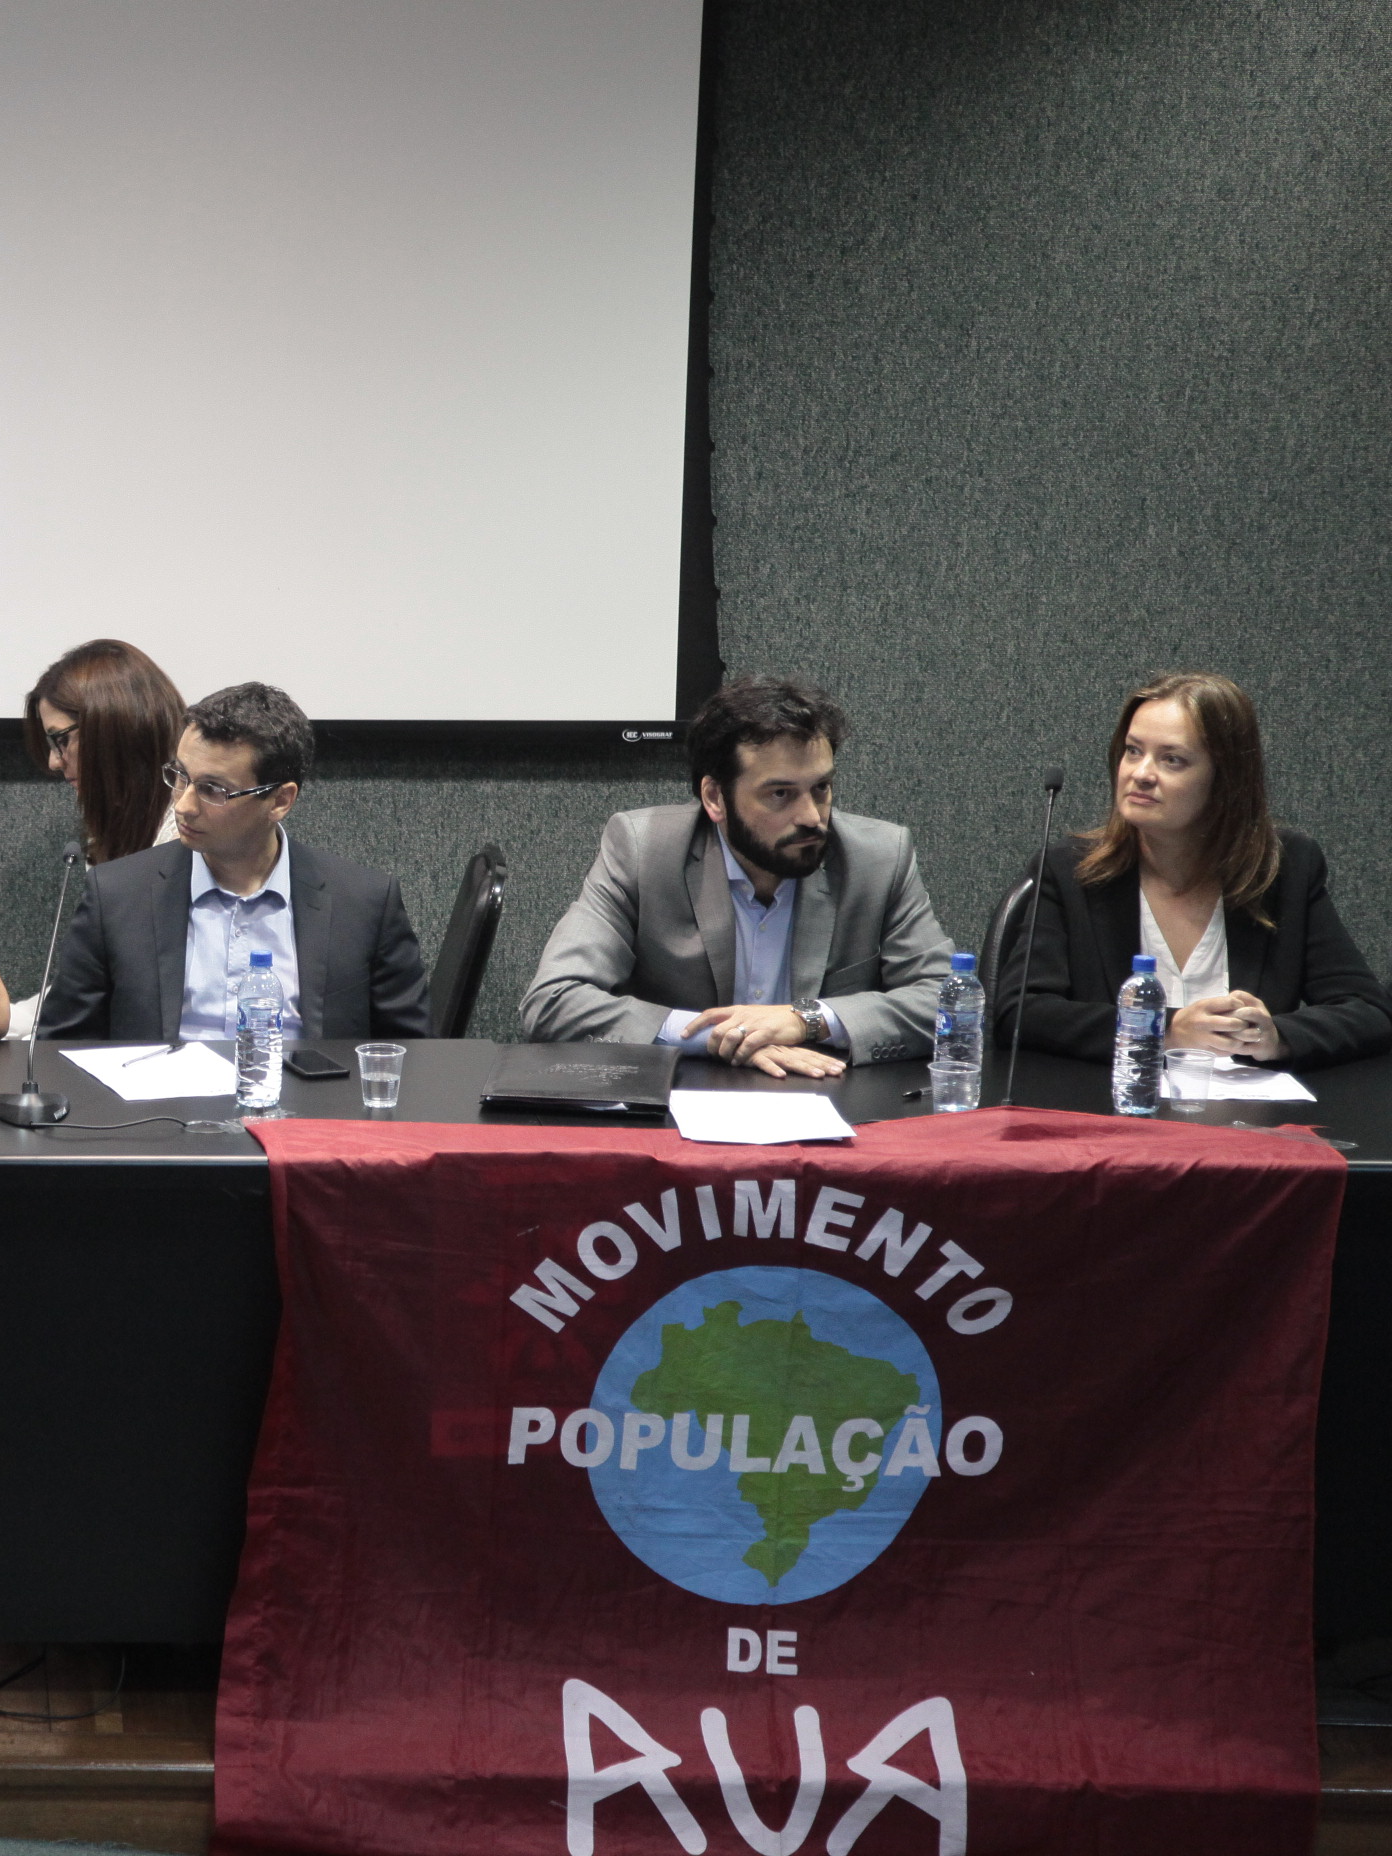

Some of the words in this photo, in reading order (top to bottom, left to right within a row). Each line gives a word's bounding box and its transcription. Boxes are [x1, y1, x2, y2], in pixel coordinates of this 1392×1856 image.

[509, 1179, 1014, 1335] MOVIMENTO
[507, 1404, 1004, 1492] POPULAÇÃO
[726, 1627, 798, 1676] DE
